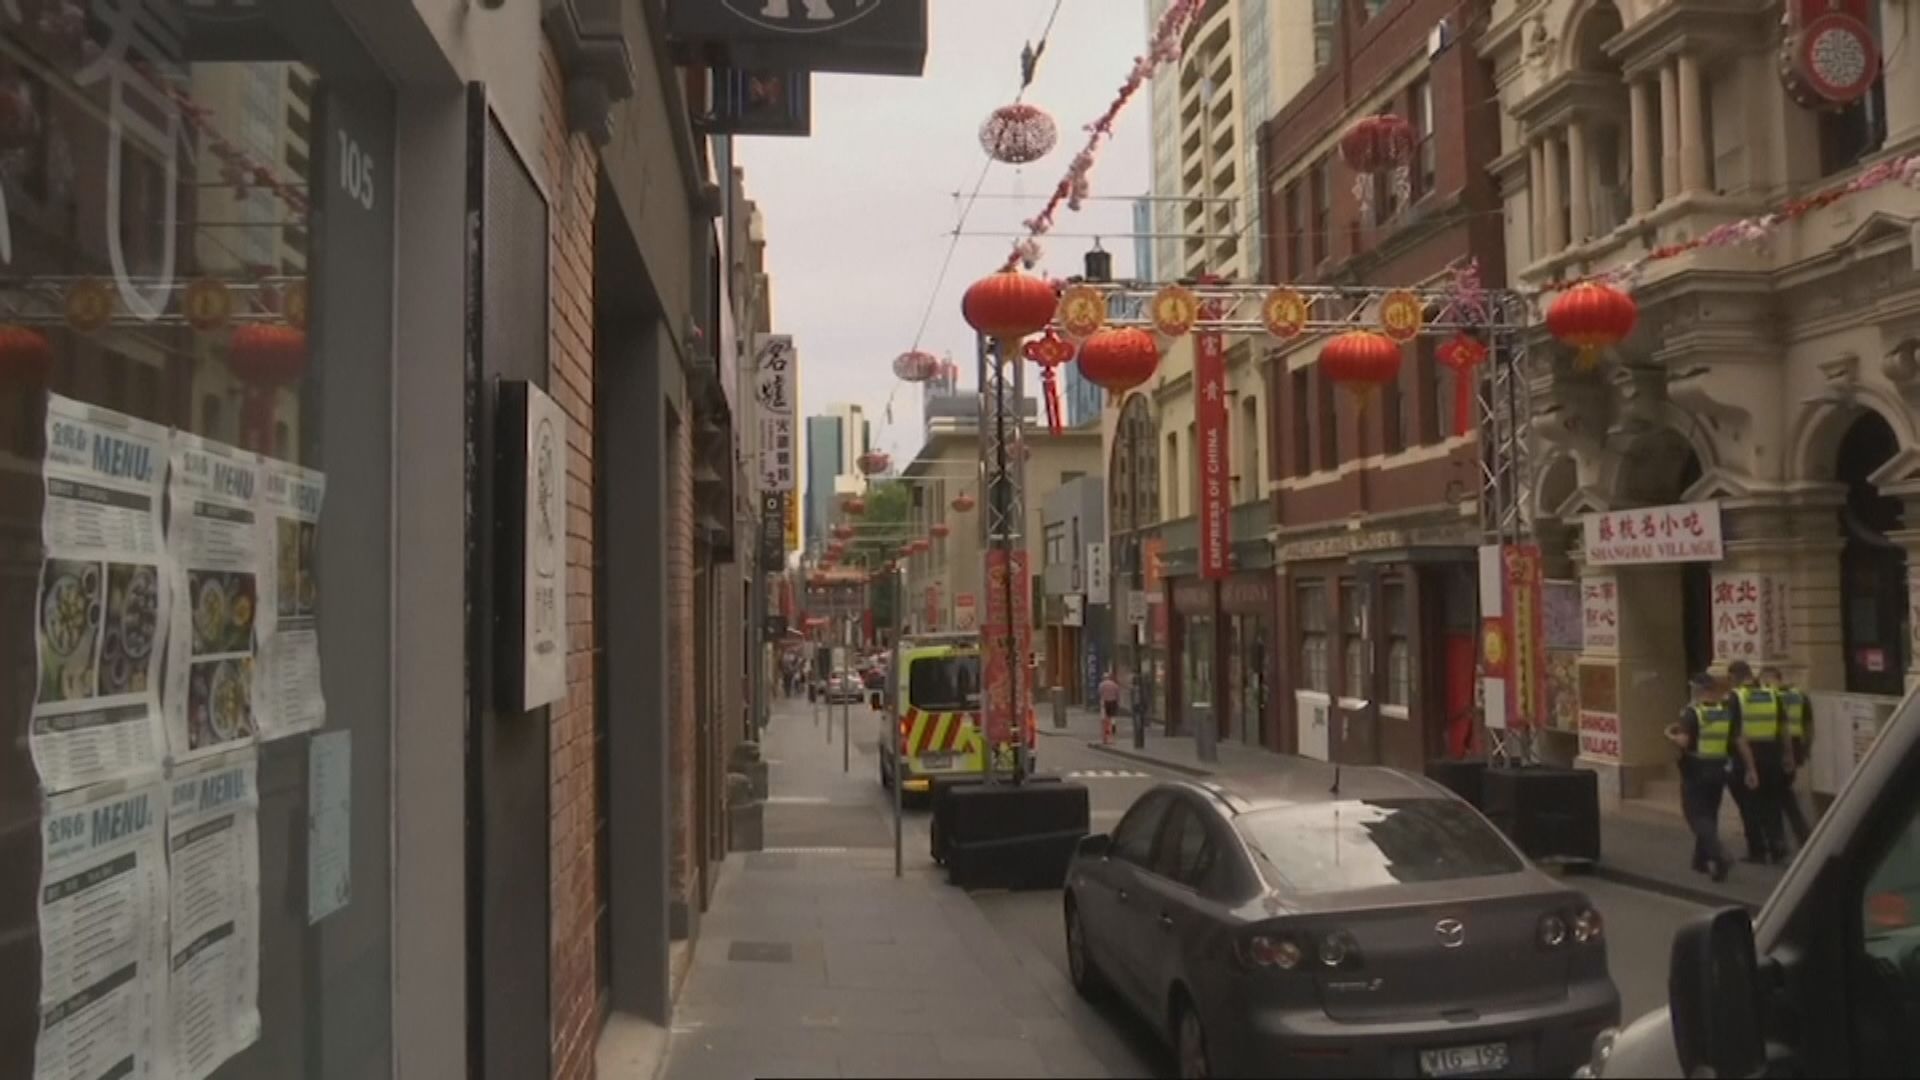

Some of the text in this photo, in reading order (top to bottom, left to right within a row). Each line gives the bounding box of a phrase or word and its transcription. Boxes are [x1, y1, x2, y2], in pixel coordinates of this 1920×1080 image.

[338, 130, 374, 211] 105
[93, 434, 150, 481] MENU
[213, 462, 255, 500] MENU
[1207, 428, 1222, 569] EMPRESS OF CHINA
[1590, 539, 1718, 561] SHANGHAI VILLAGE
[1582, 736, 1618, 757] VILLAGE
[198, 768, 243, 811] MENU
[92, 794, 148, 848] MENU
